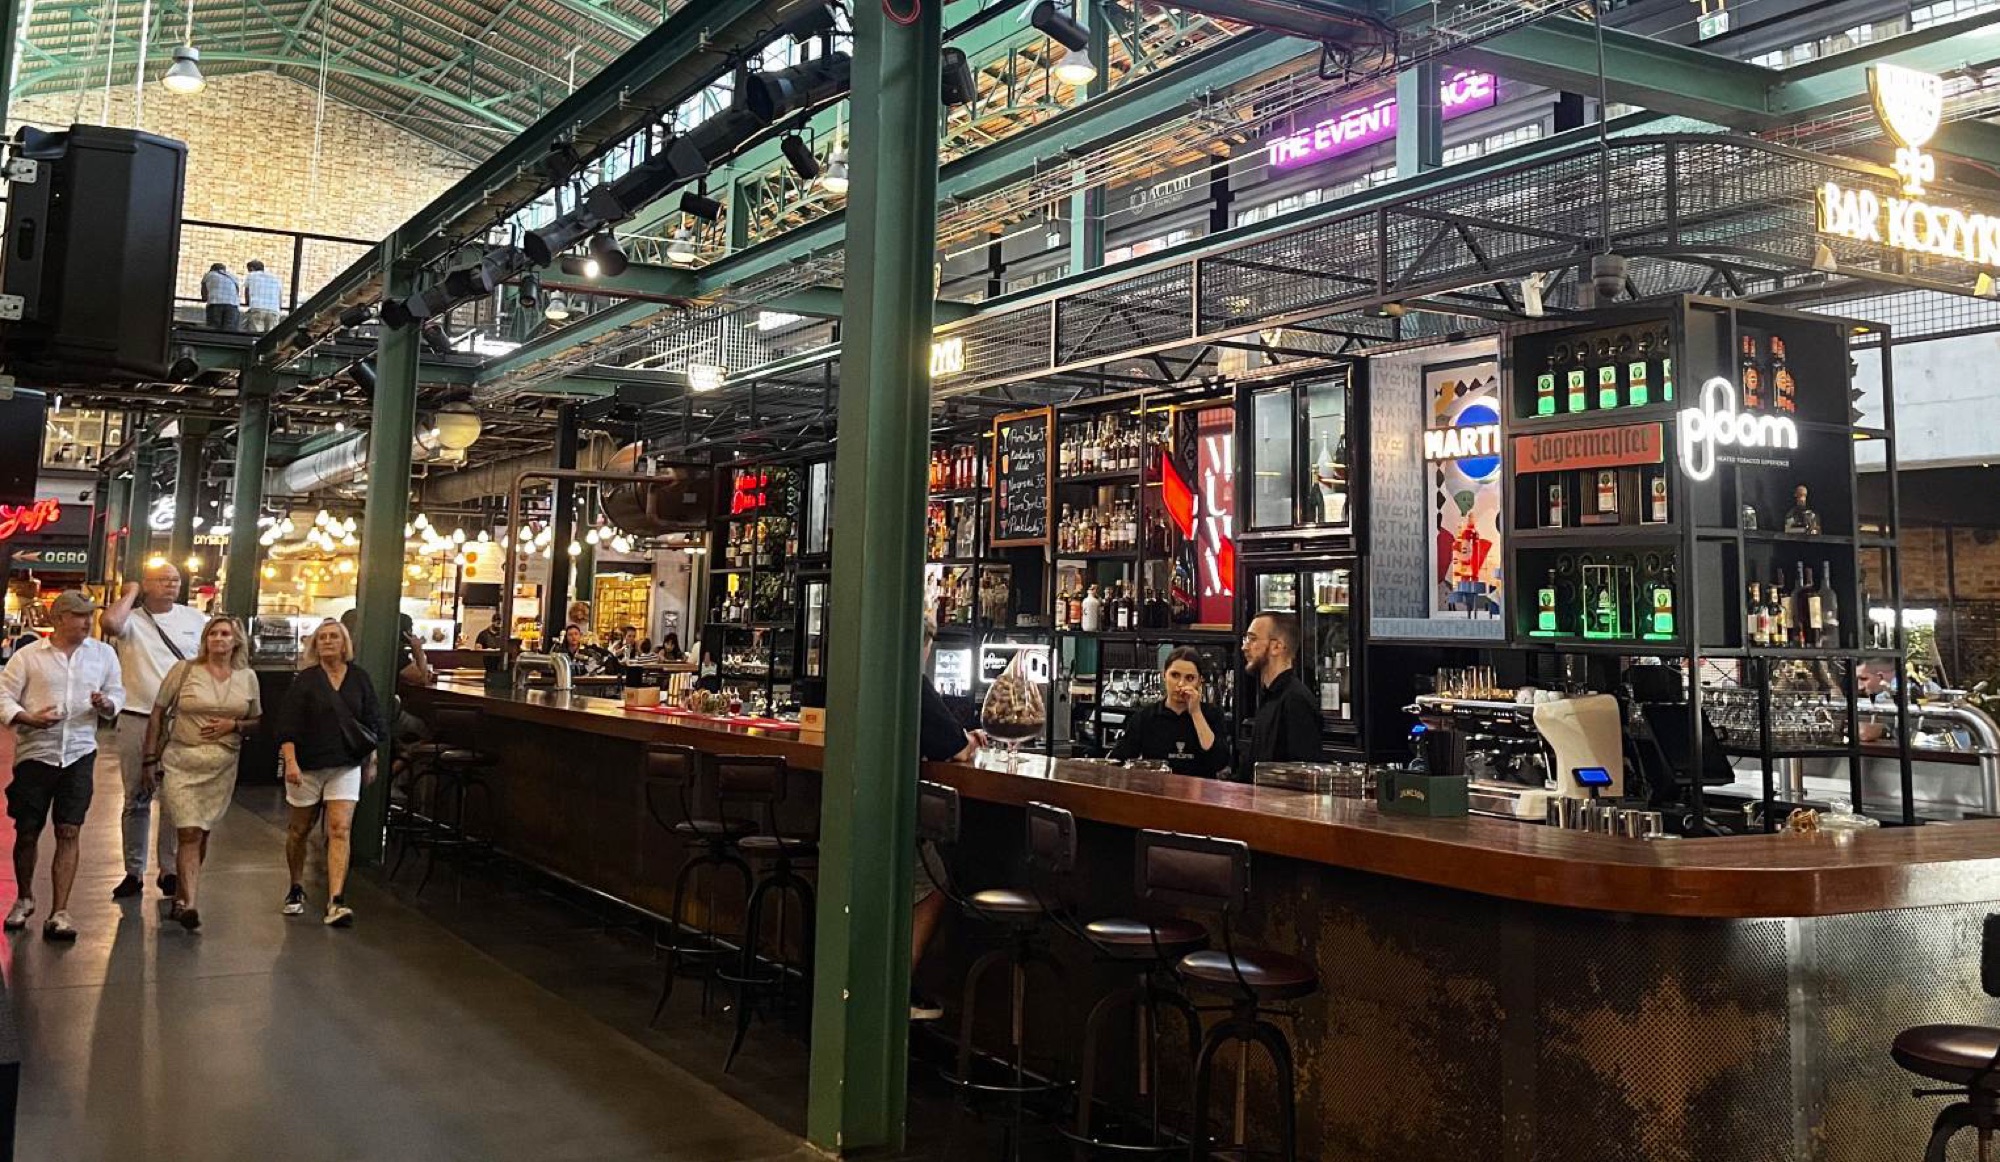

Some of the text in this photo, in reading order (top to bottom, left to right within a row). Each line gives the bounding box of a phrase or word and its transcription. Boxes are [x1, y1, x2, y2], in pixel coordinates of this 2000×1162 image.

[1266, 126, 1311, 166] THE
[1315, 98, 1396, 150] EVENT
[1816, 182, 1880, 241] BAR
